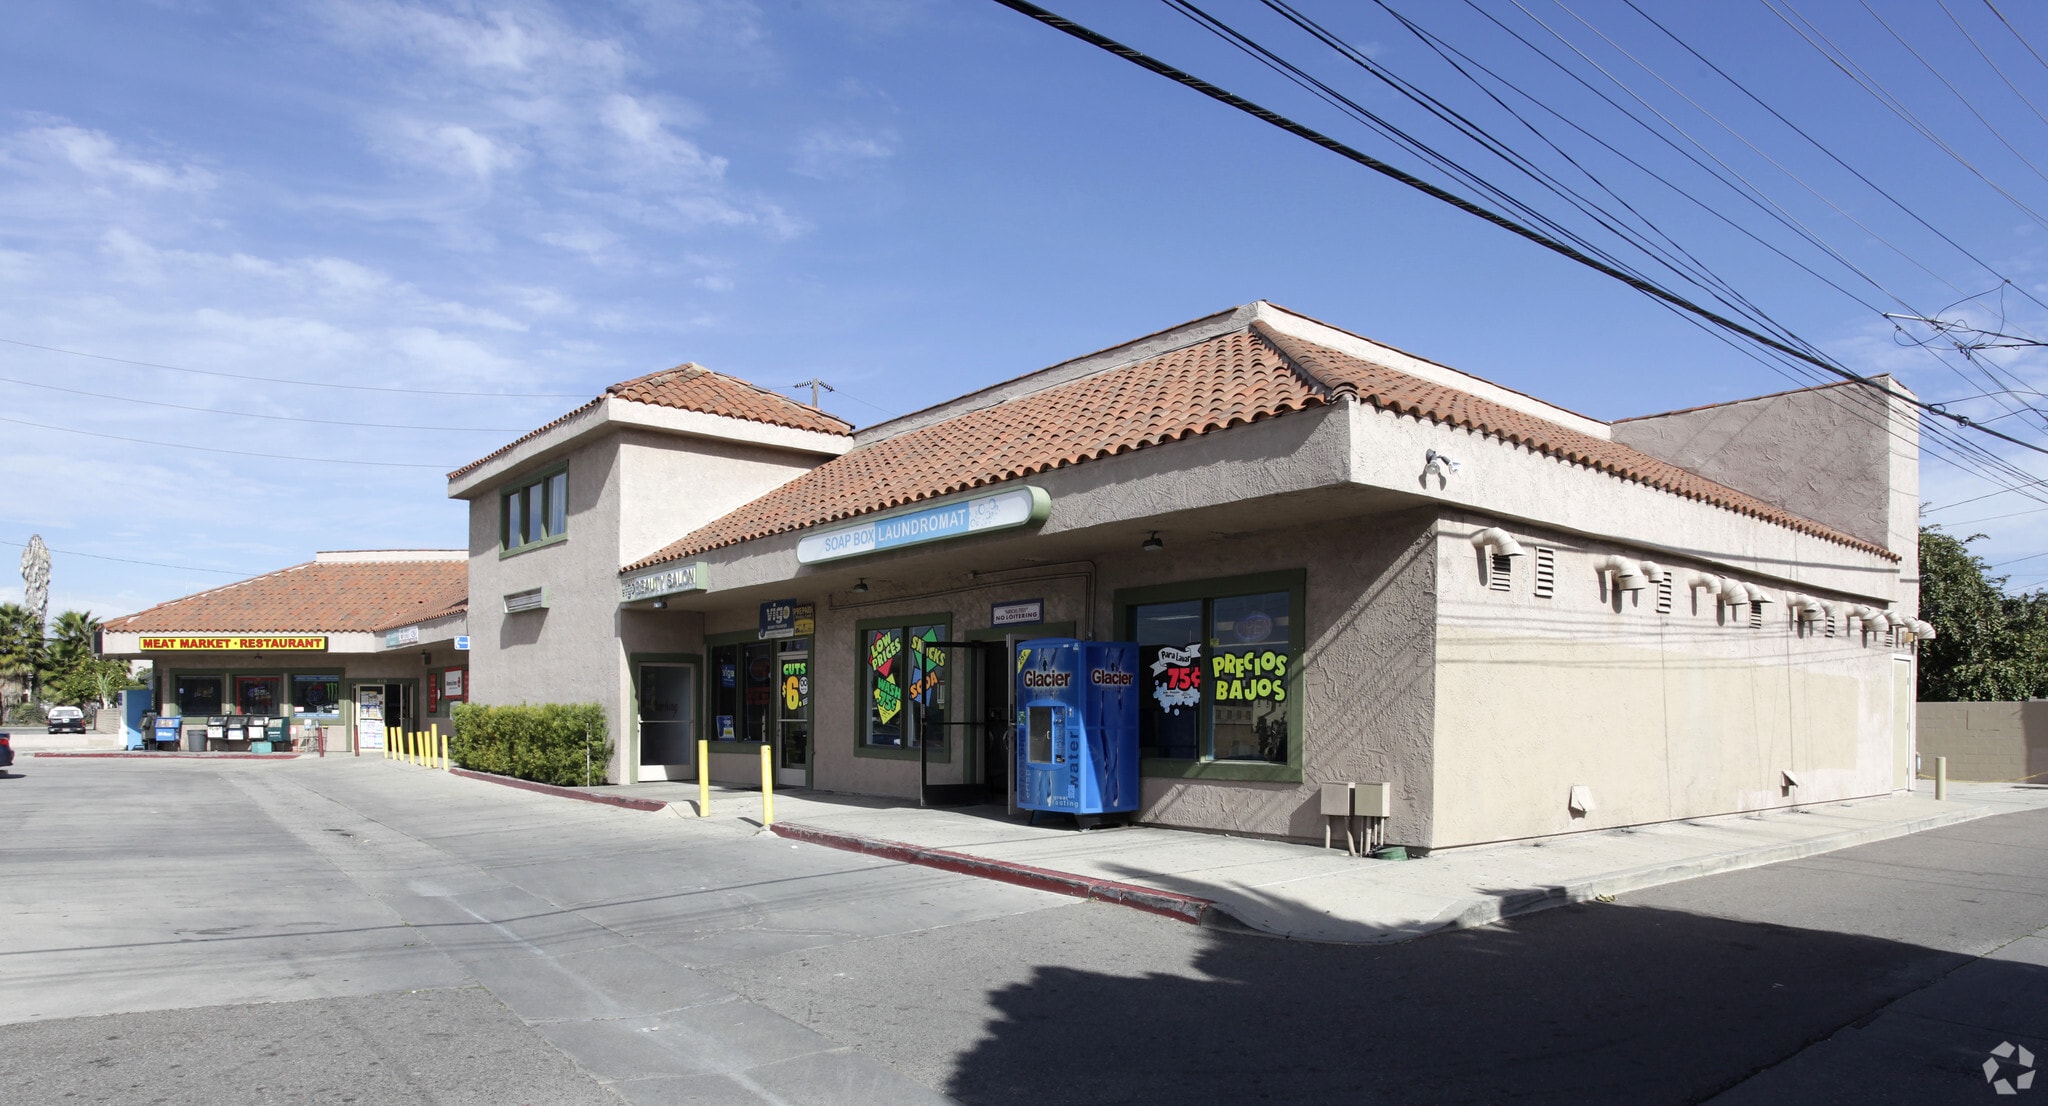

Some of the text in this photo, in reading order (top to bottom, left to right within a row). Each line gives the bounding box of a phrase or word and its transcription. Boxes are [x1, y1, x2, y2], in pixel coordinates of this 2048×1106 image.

[825, 509, 966, 552] SOAP BOX LAUNDROMAT
[635, 575, 666, 596] BEAUTY
[667, 568, 696, 588] SALON
[767, 603, 790, 624] vigo
[1006, 611, 1038, 620] LOITERING
[143, 638, 322, 648] MEAT MARKET RESTAURANT
[871, 631, 891, 657] LOW
[872, 637, 901, 671] PRICES
[1161, 650, 1176, 660] Para
[1212, 651, 1288, 678] PRECIOS
[783, 662, 806, 675] CUTS
[1024, 670, 1071, 688] Glacier
[1092, 669, 1133, 685] Glacier
[1167, 666, 1201, 690] 75¢
[878, 677, 901, 700] WASH
[1216, 678, 1286, 701] BAJOS
[880, 689, 898, 712] 75¢
[1068, 731, 1080, 788] water
